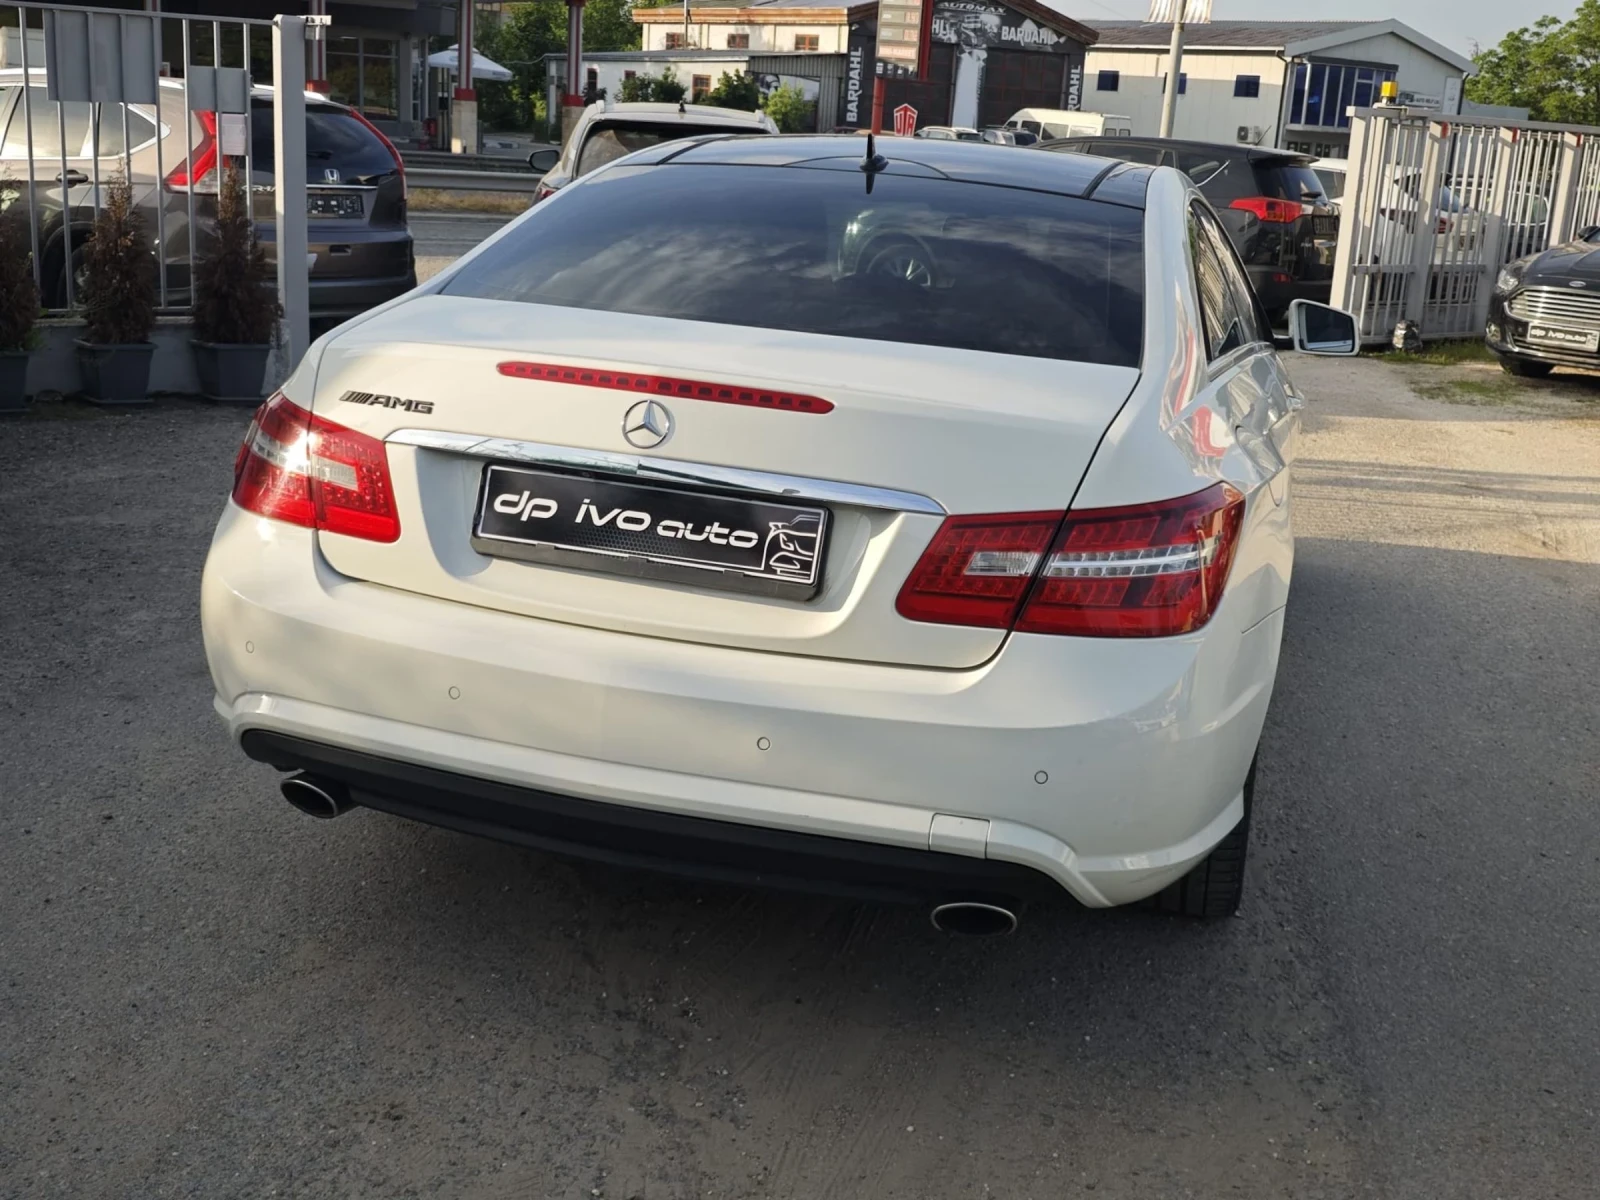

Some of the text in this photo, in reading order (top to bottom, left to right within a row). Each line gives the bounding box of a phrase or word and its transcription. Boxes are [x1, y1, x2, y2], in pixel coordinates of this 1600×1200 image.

[941, 2, 1006, 14] AUTOMAX
[1001, 26, 1054, 46] BARDAHL
[846, 47, 862, 122] BARDAHL
[1068, 64, 1081, 111] RDAHL
[368, 394, 435, 414] AMG
[493, 490, 759, 549] dp ivo auto
